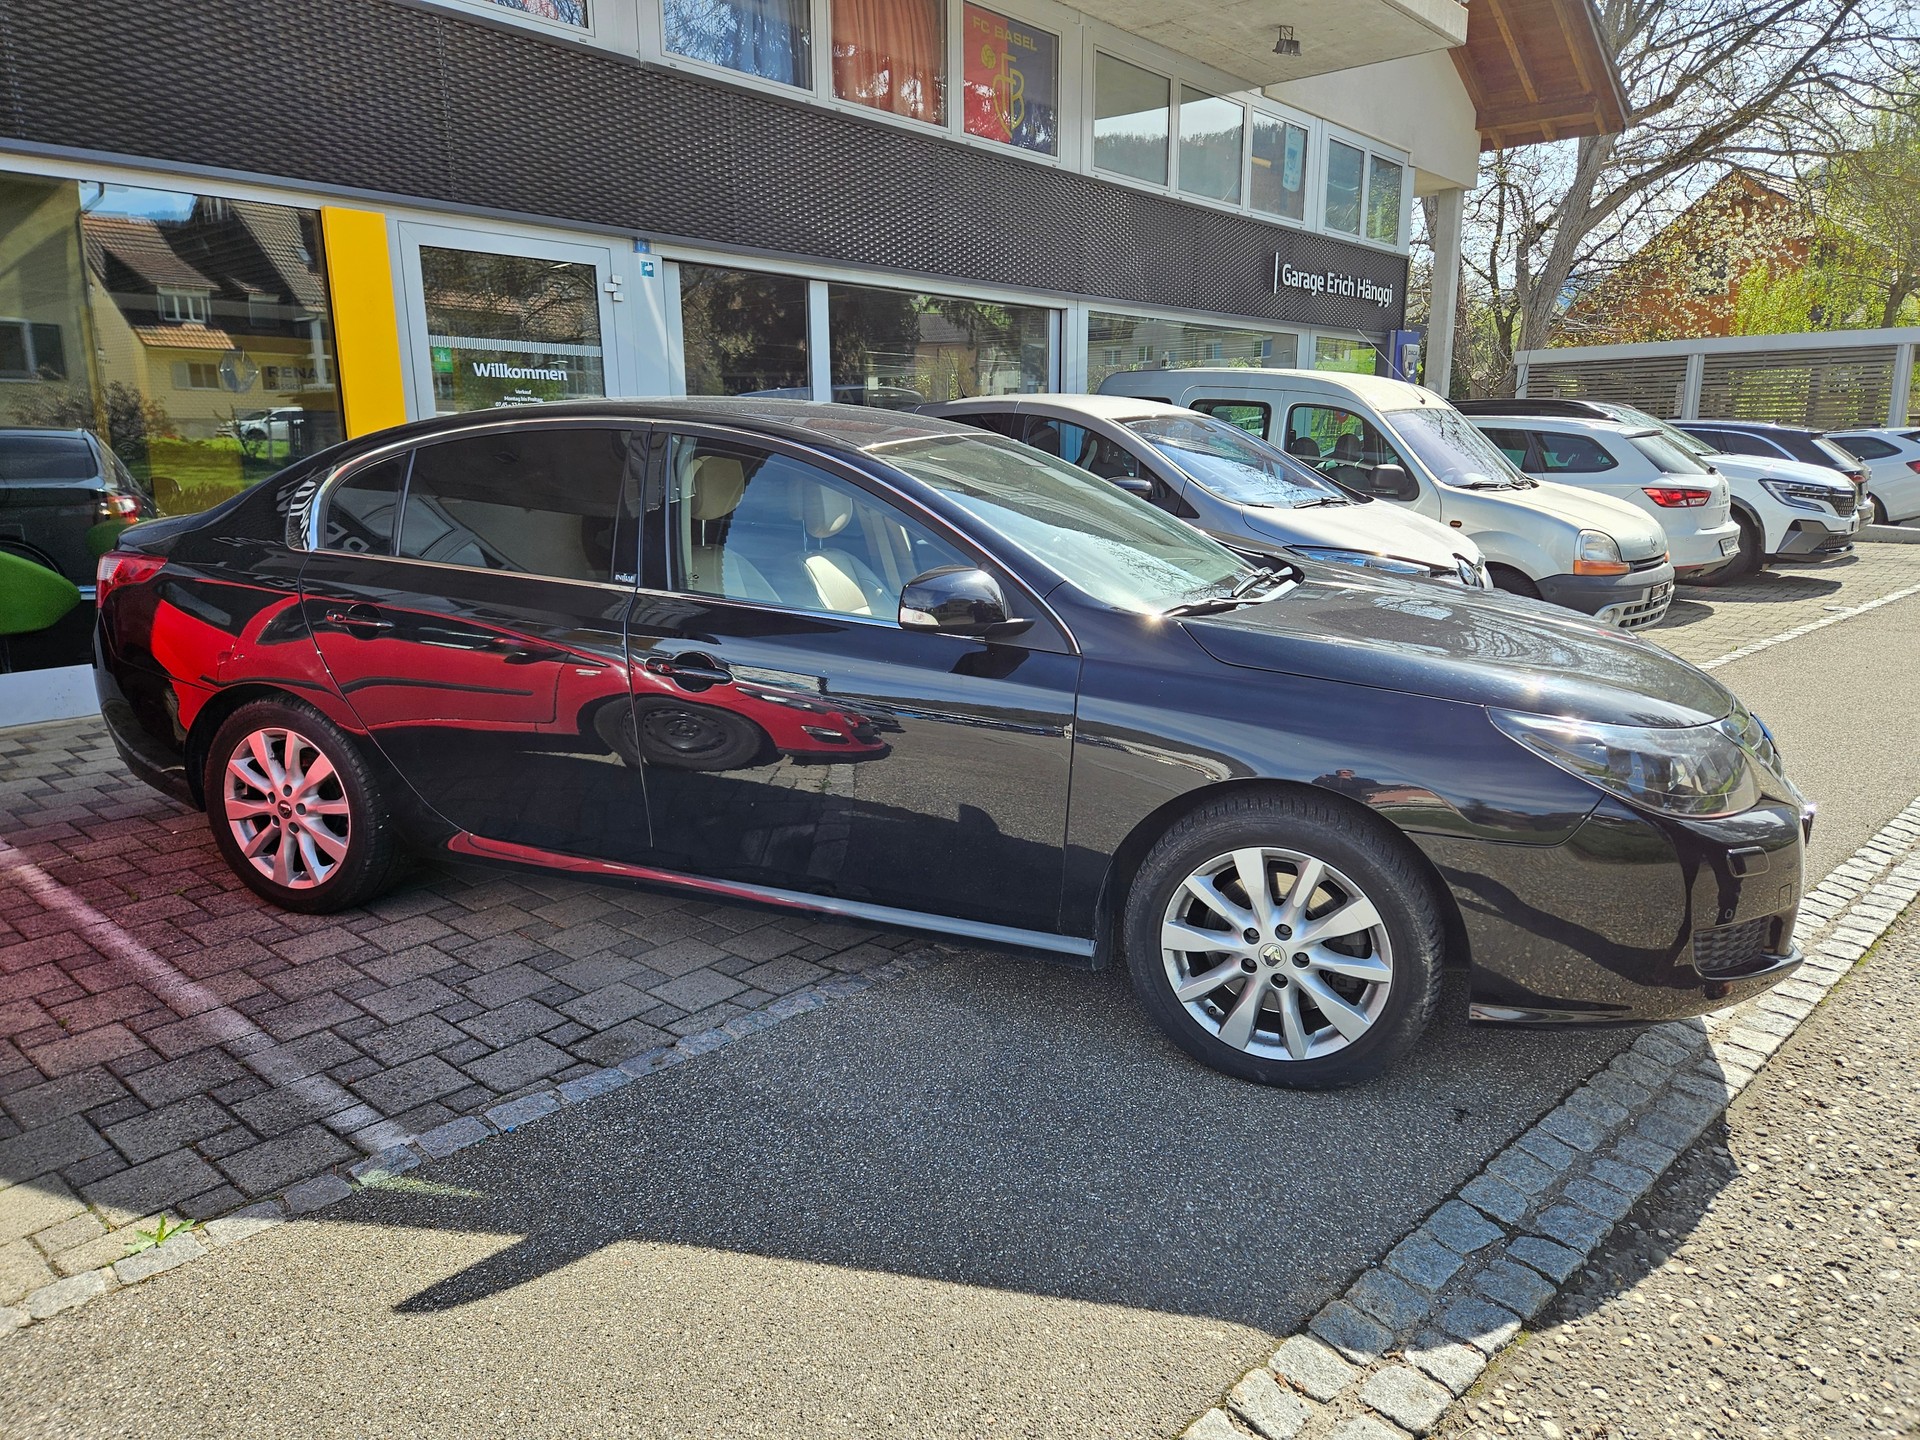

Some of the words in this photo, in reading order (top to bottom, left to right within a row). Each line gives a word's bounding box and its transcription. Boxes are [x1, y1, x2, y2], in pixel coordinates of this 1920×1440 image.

[973, 17, 991, 33] FC
[995, 26, 1037, 50] BASEL
[1282, 263, 1325, 296] Garage
[1327, 271, 1354, 297] Erich
[1357, 277, 1393, 308] Hänggi
[473, 362, 568, 381] Willkommen
